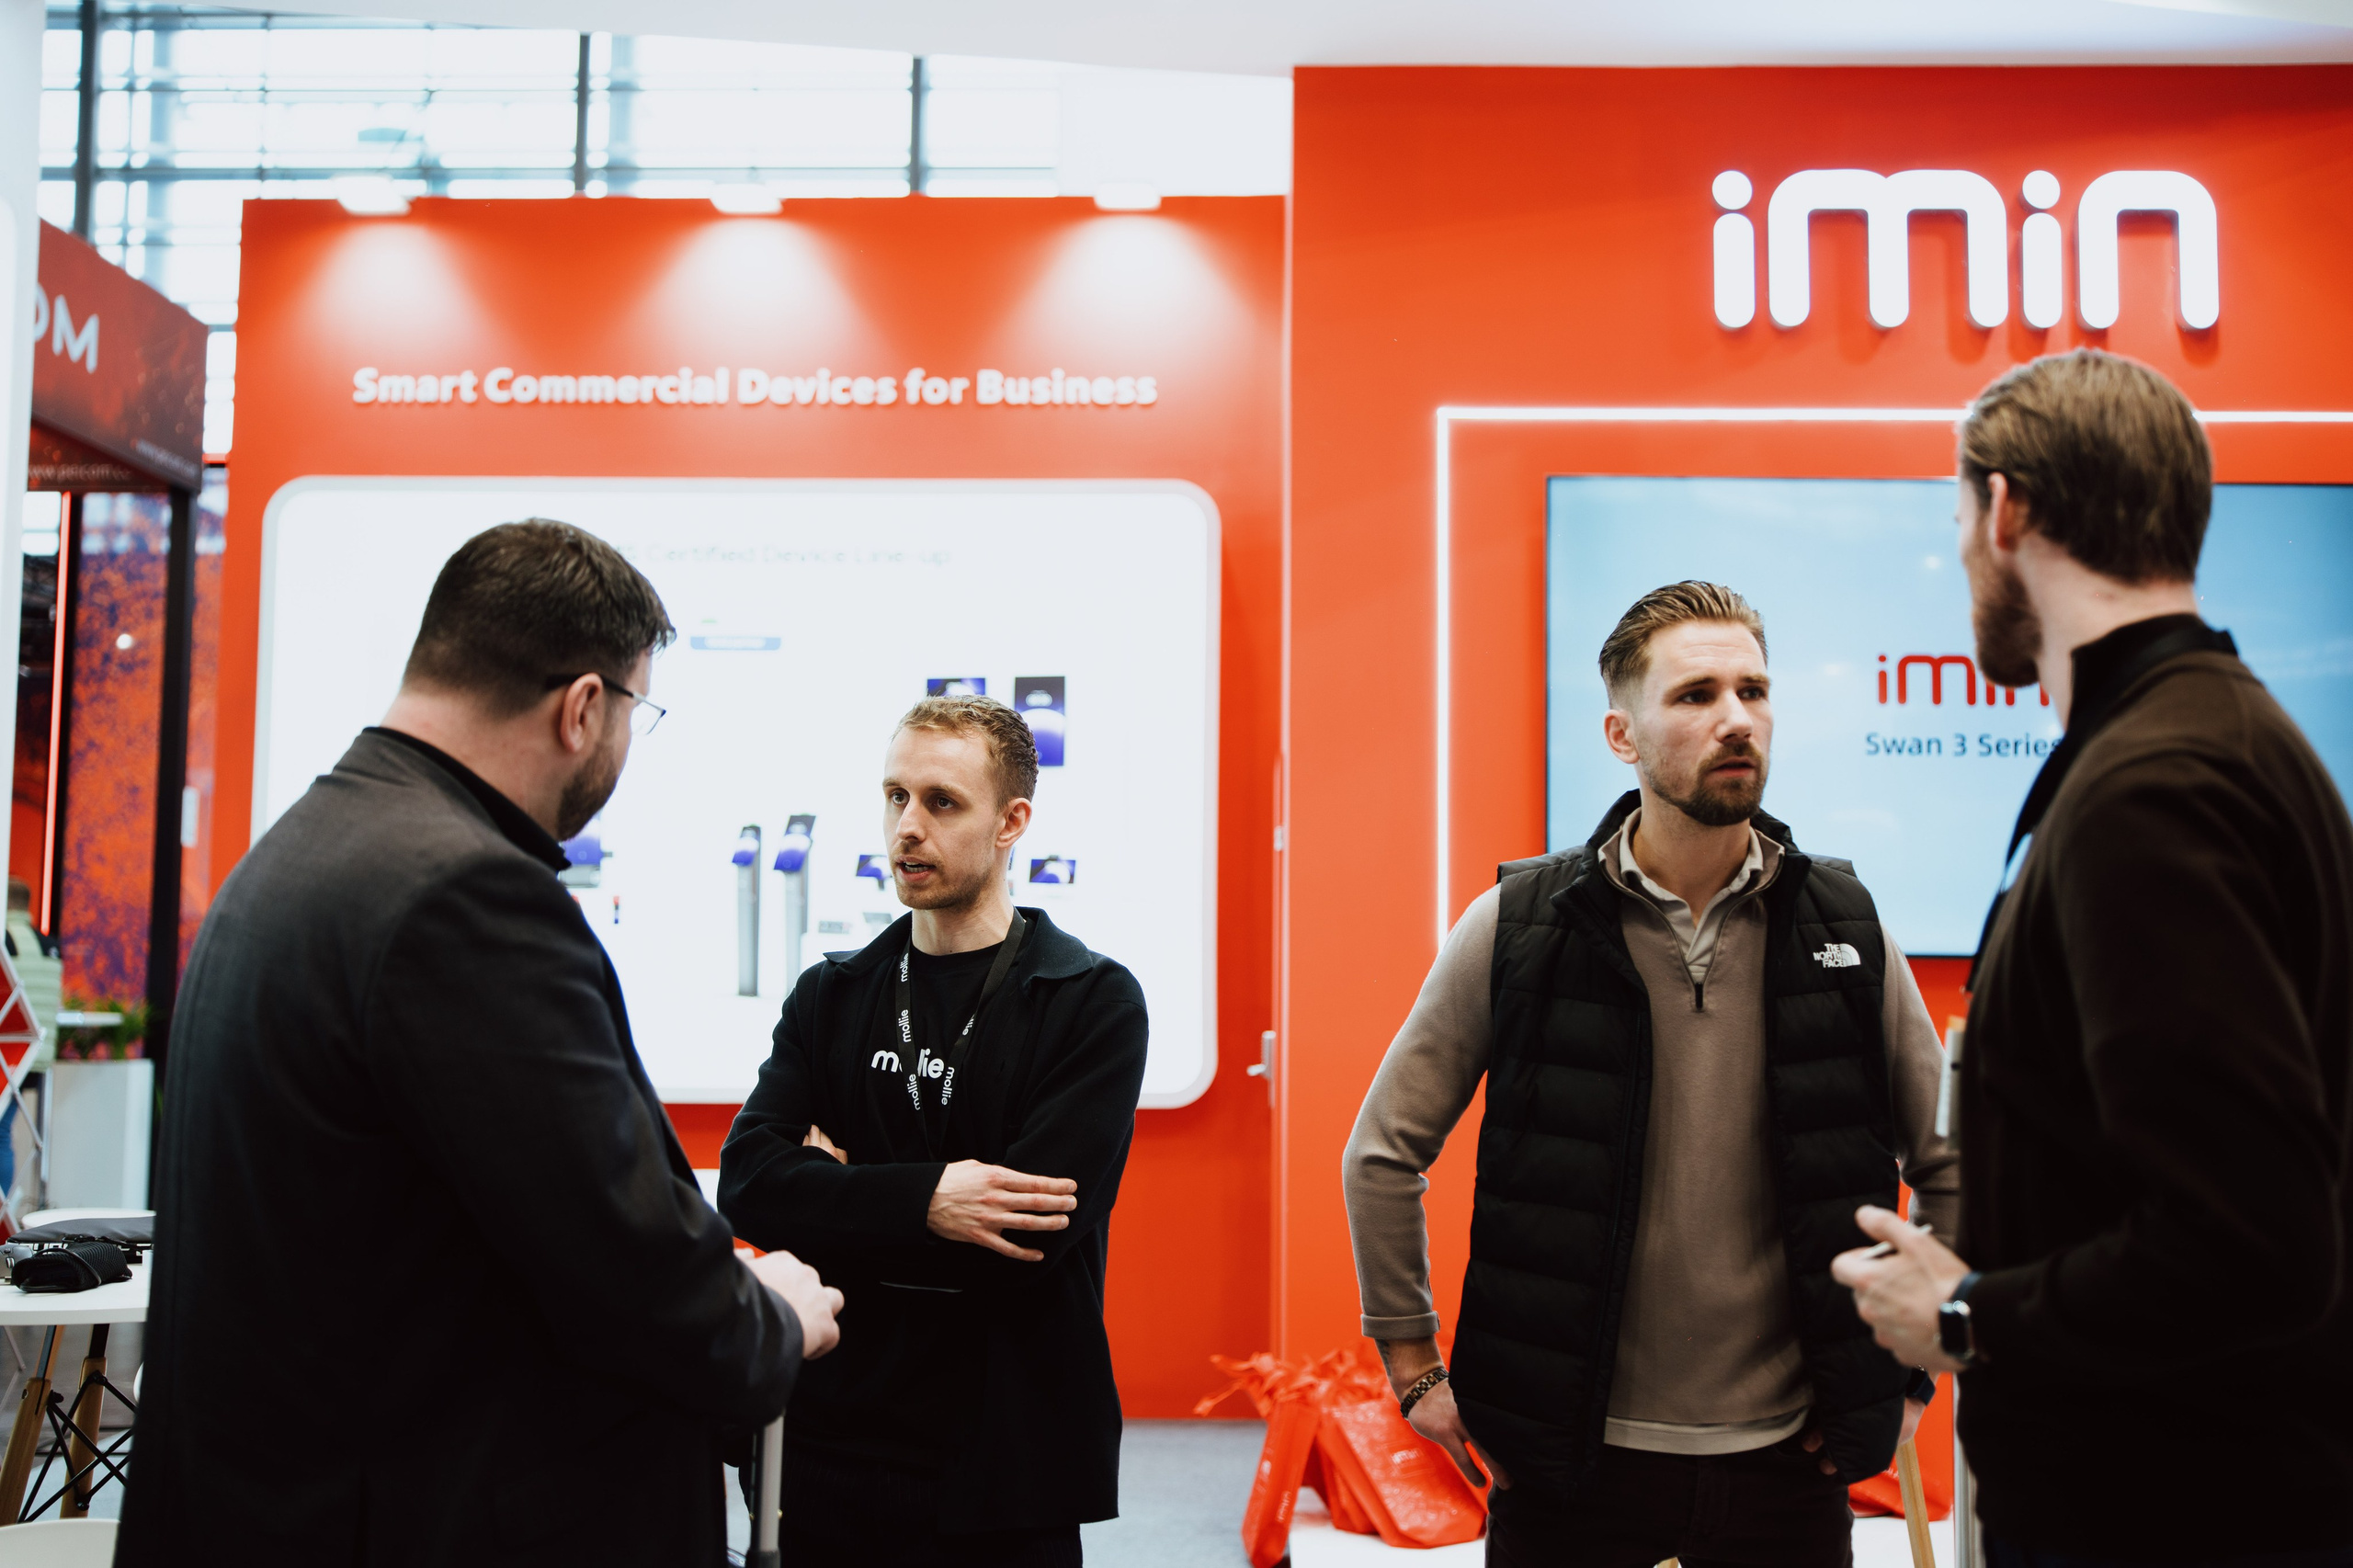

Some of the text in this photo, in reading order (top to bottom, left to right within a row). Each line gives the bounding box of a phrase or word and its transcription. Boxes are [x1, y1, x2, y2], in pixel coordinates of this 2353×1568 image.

[352, 367, 1157, 404] Smart Commercial Devices for Business
[1865, 733, 1942, 756] Swan
[1953, 733, 1967, 756] 3
[1813, 951, 1842, 960] NORTH
[1824, 943, 1840, 952] THE
[900, 952, 909, 983] mollie
[1823, 959, 1844, 968] FACE
[898, 1009, 912, 1043] mollie
[871, 1048, 945, 1079] mlie
[906, 1074, 921, 1110] mollie
[941, 1066, 955, 1106] mollie
